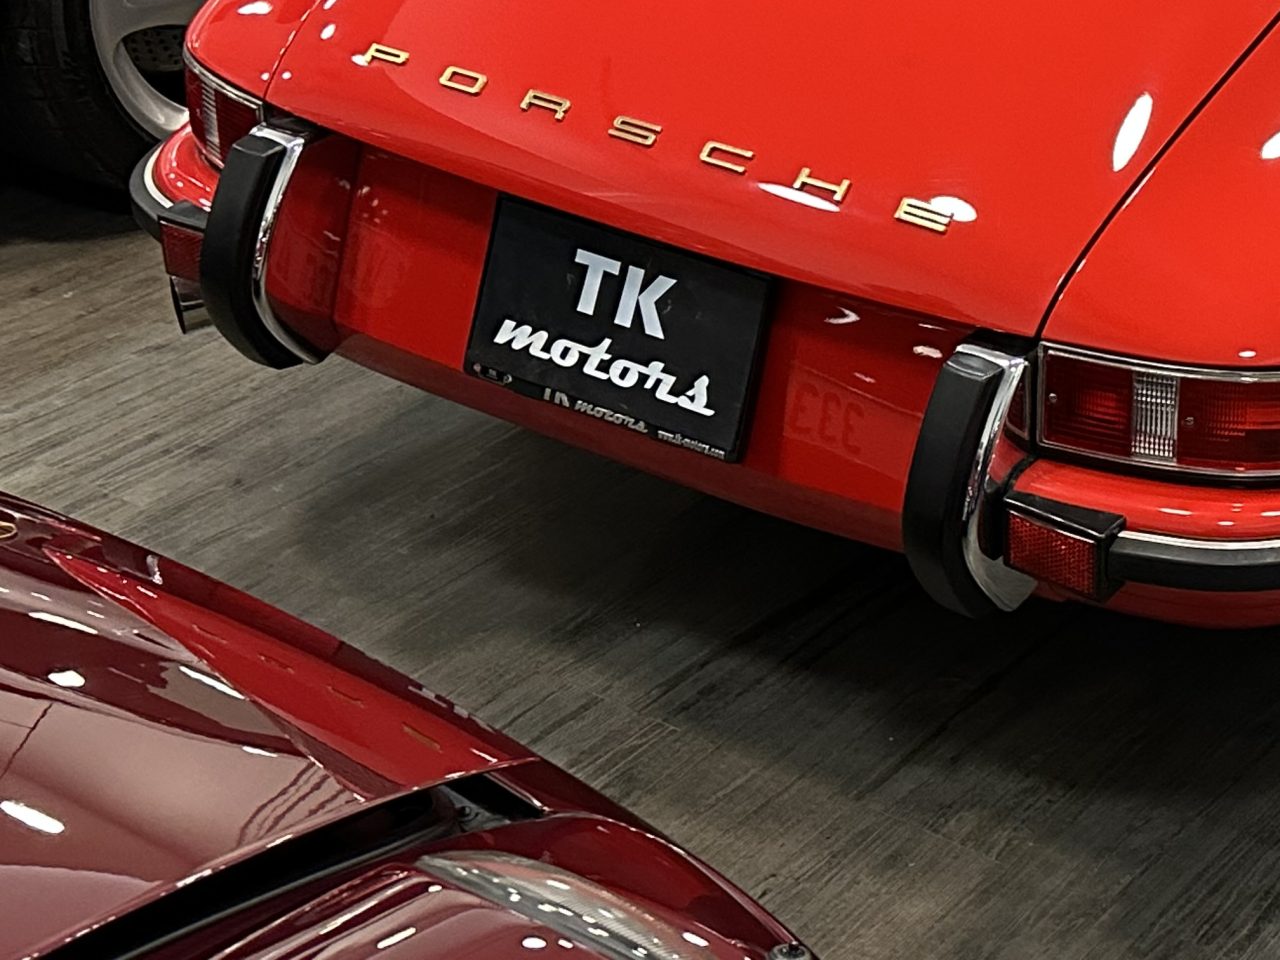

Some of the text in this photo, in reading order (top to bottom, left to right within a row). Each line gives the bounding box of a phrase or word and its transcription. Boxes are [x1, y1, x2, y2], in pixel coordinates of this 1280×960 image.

[364, 42, 953, 233] PORSCHE
[574, 248, 677, 340] TK
[493, 319, 715, 417] motors
